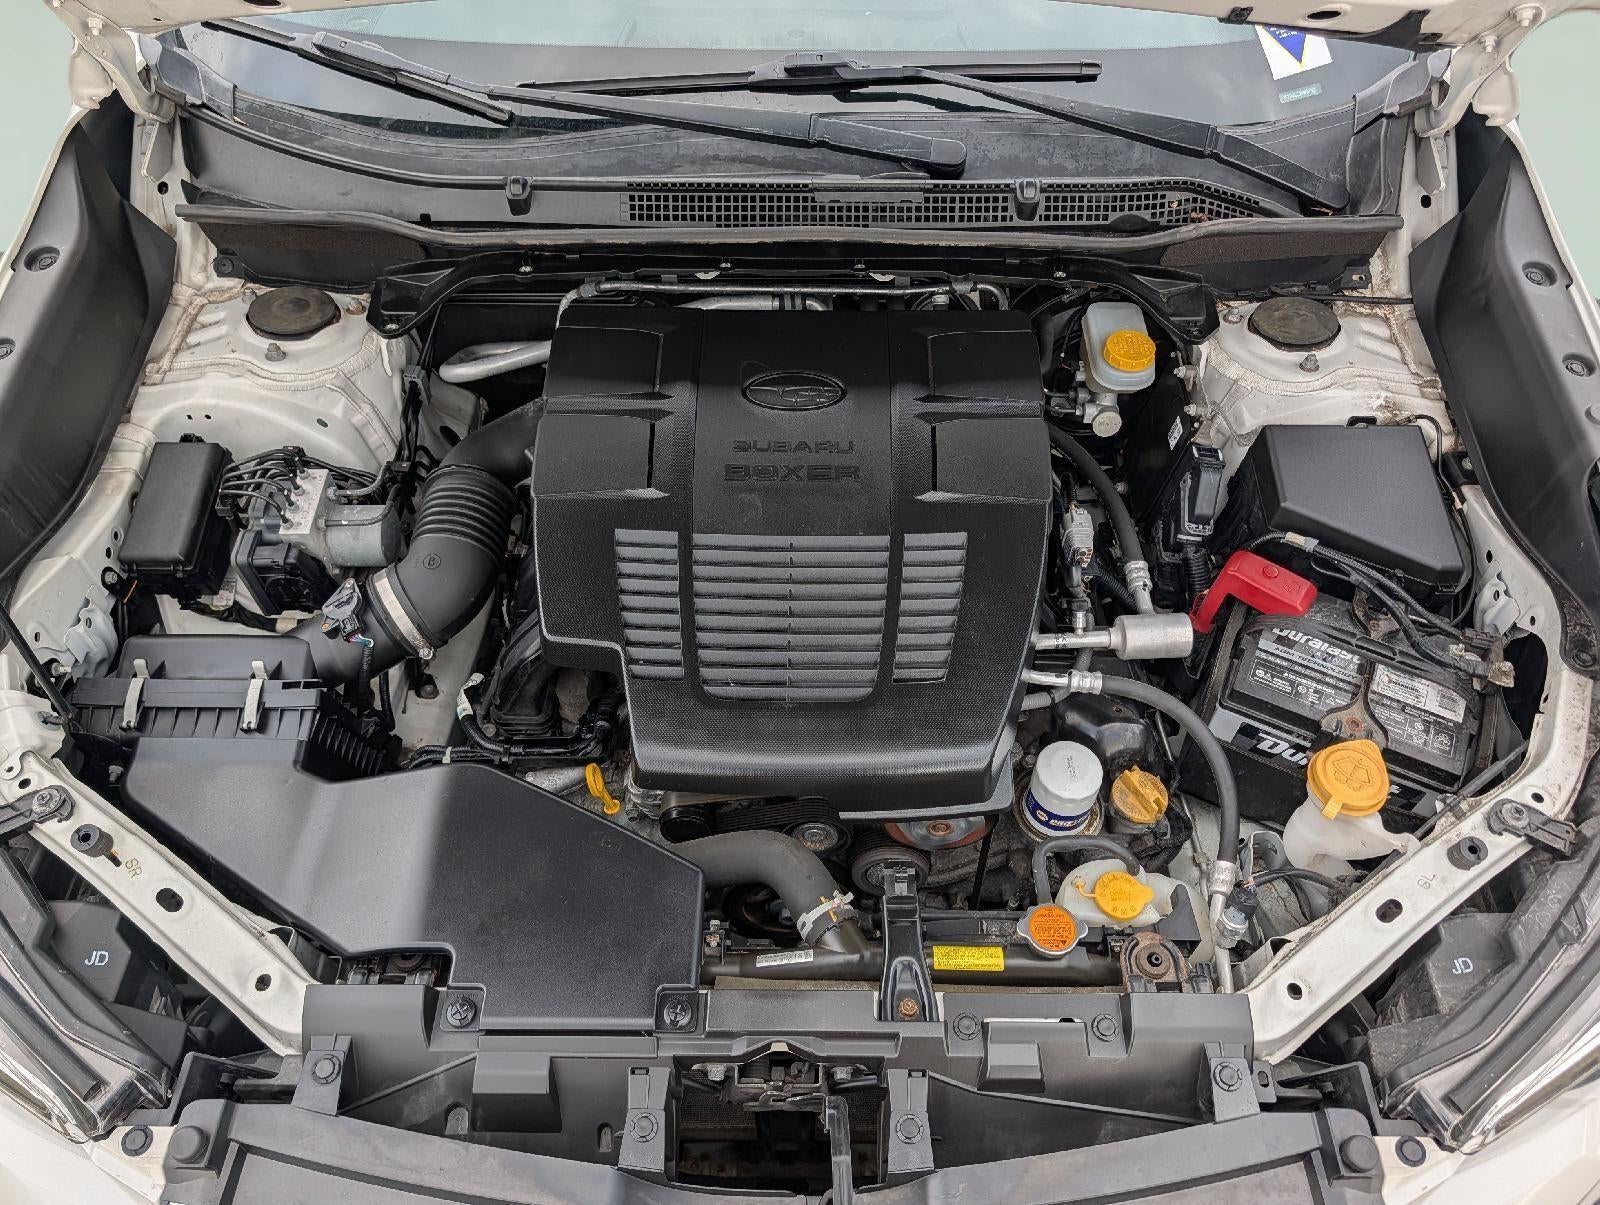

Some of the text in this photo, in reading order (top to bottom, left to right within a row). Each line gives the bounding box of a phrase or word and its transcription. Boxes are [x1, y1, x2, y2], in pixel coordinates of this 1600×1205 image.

[733, 440, 855, 454] SUBARU
[723, 463, 861, 482] BOXER
[84, 950, 109, 966] JD
[1452, 957, 1474, 975] JD
